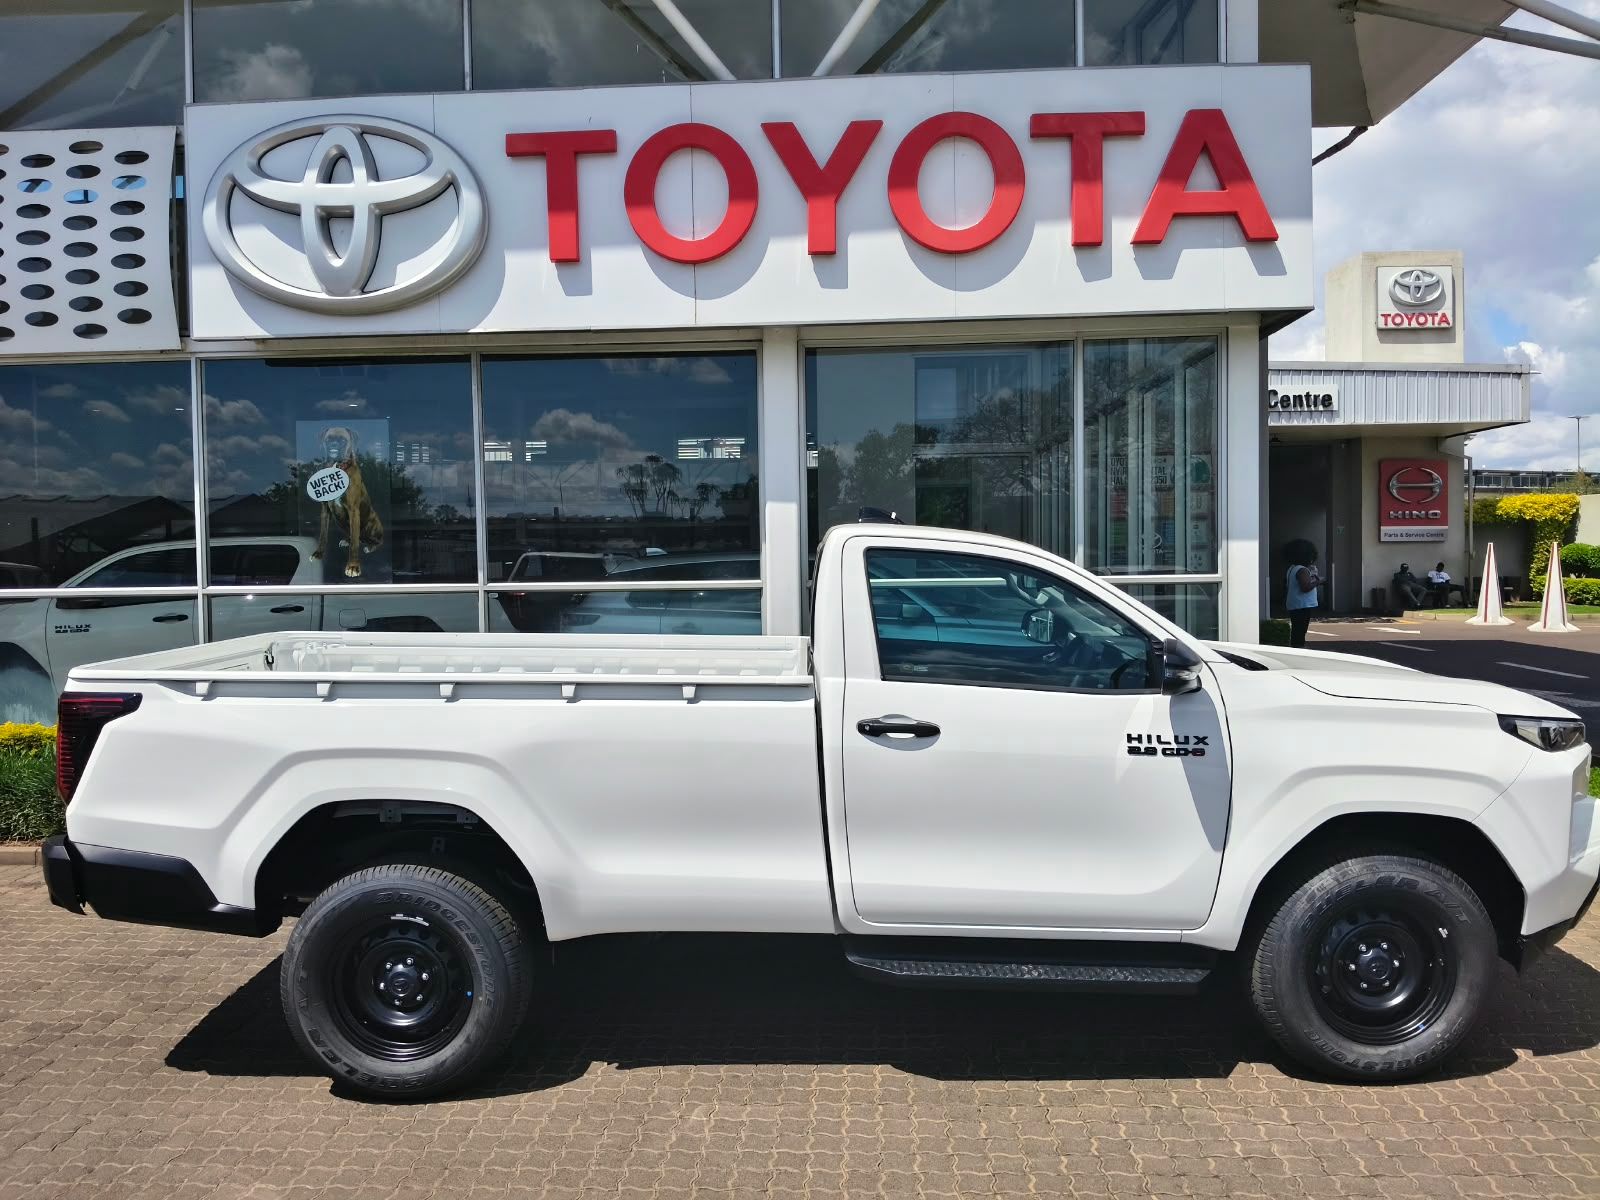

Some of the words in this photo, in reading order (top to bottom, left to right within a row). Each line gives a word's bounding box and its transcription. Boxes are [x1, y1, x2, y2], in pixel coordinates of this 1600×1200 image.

[505, 108, 1279, 265] TOYOTA
[1380, 312, 1451, 327] TOYOTA
[1268, 389, 1333, 409] Centre
[310, 470, 343, 489] WE'RE
[314, 480, 346, 499] BACK!
[1389, 510, 1442, 519] HINO
[1126, 733, 1209, 746] HILUX
[376, 891, 496, 1010] BRIDGESTONE
